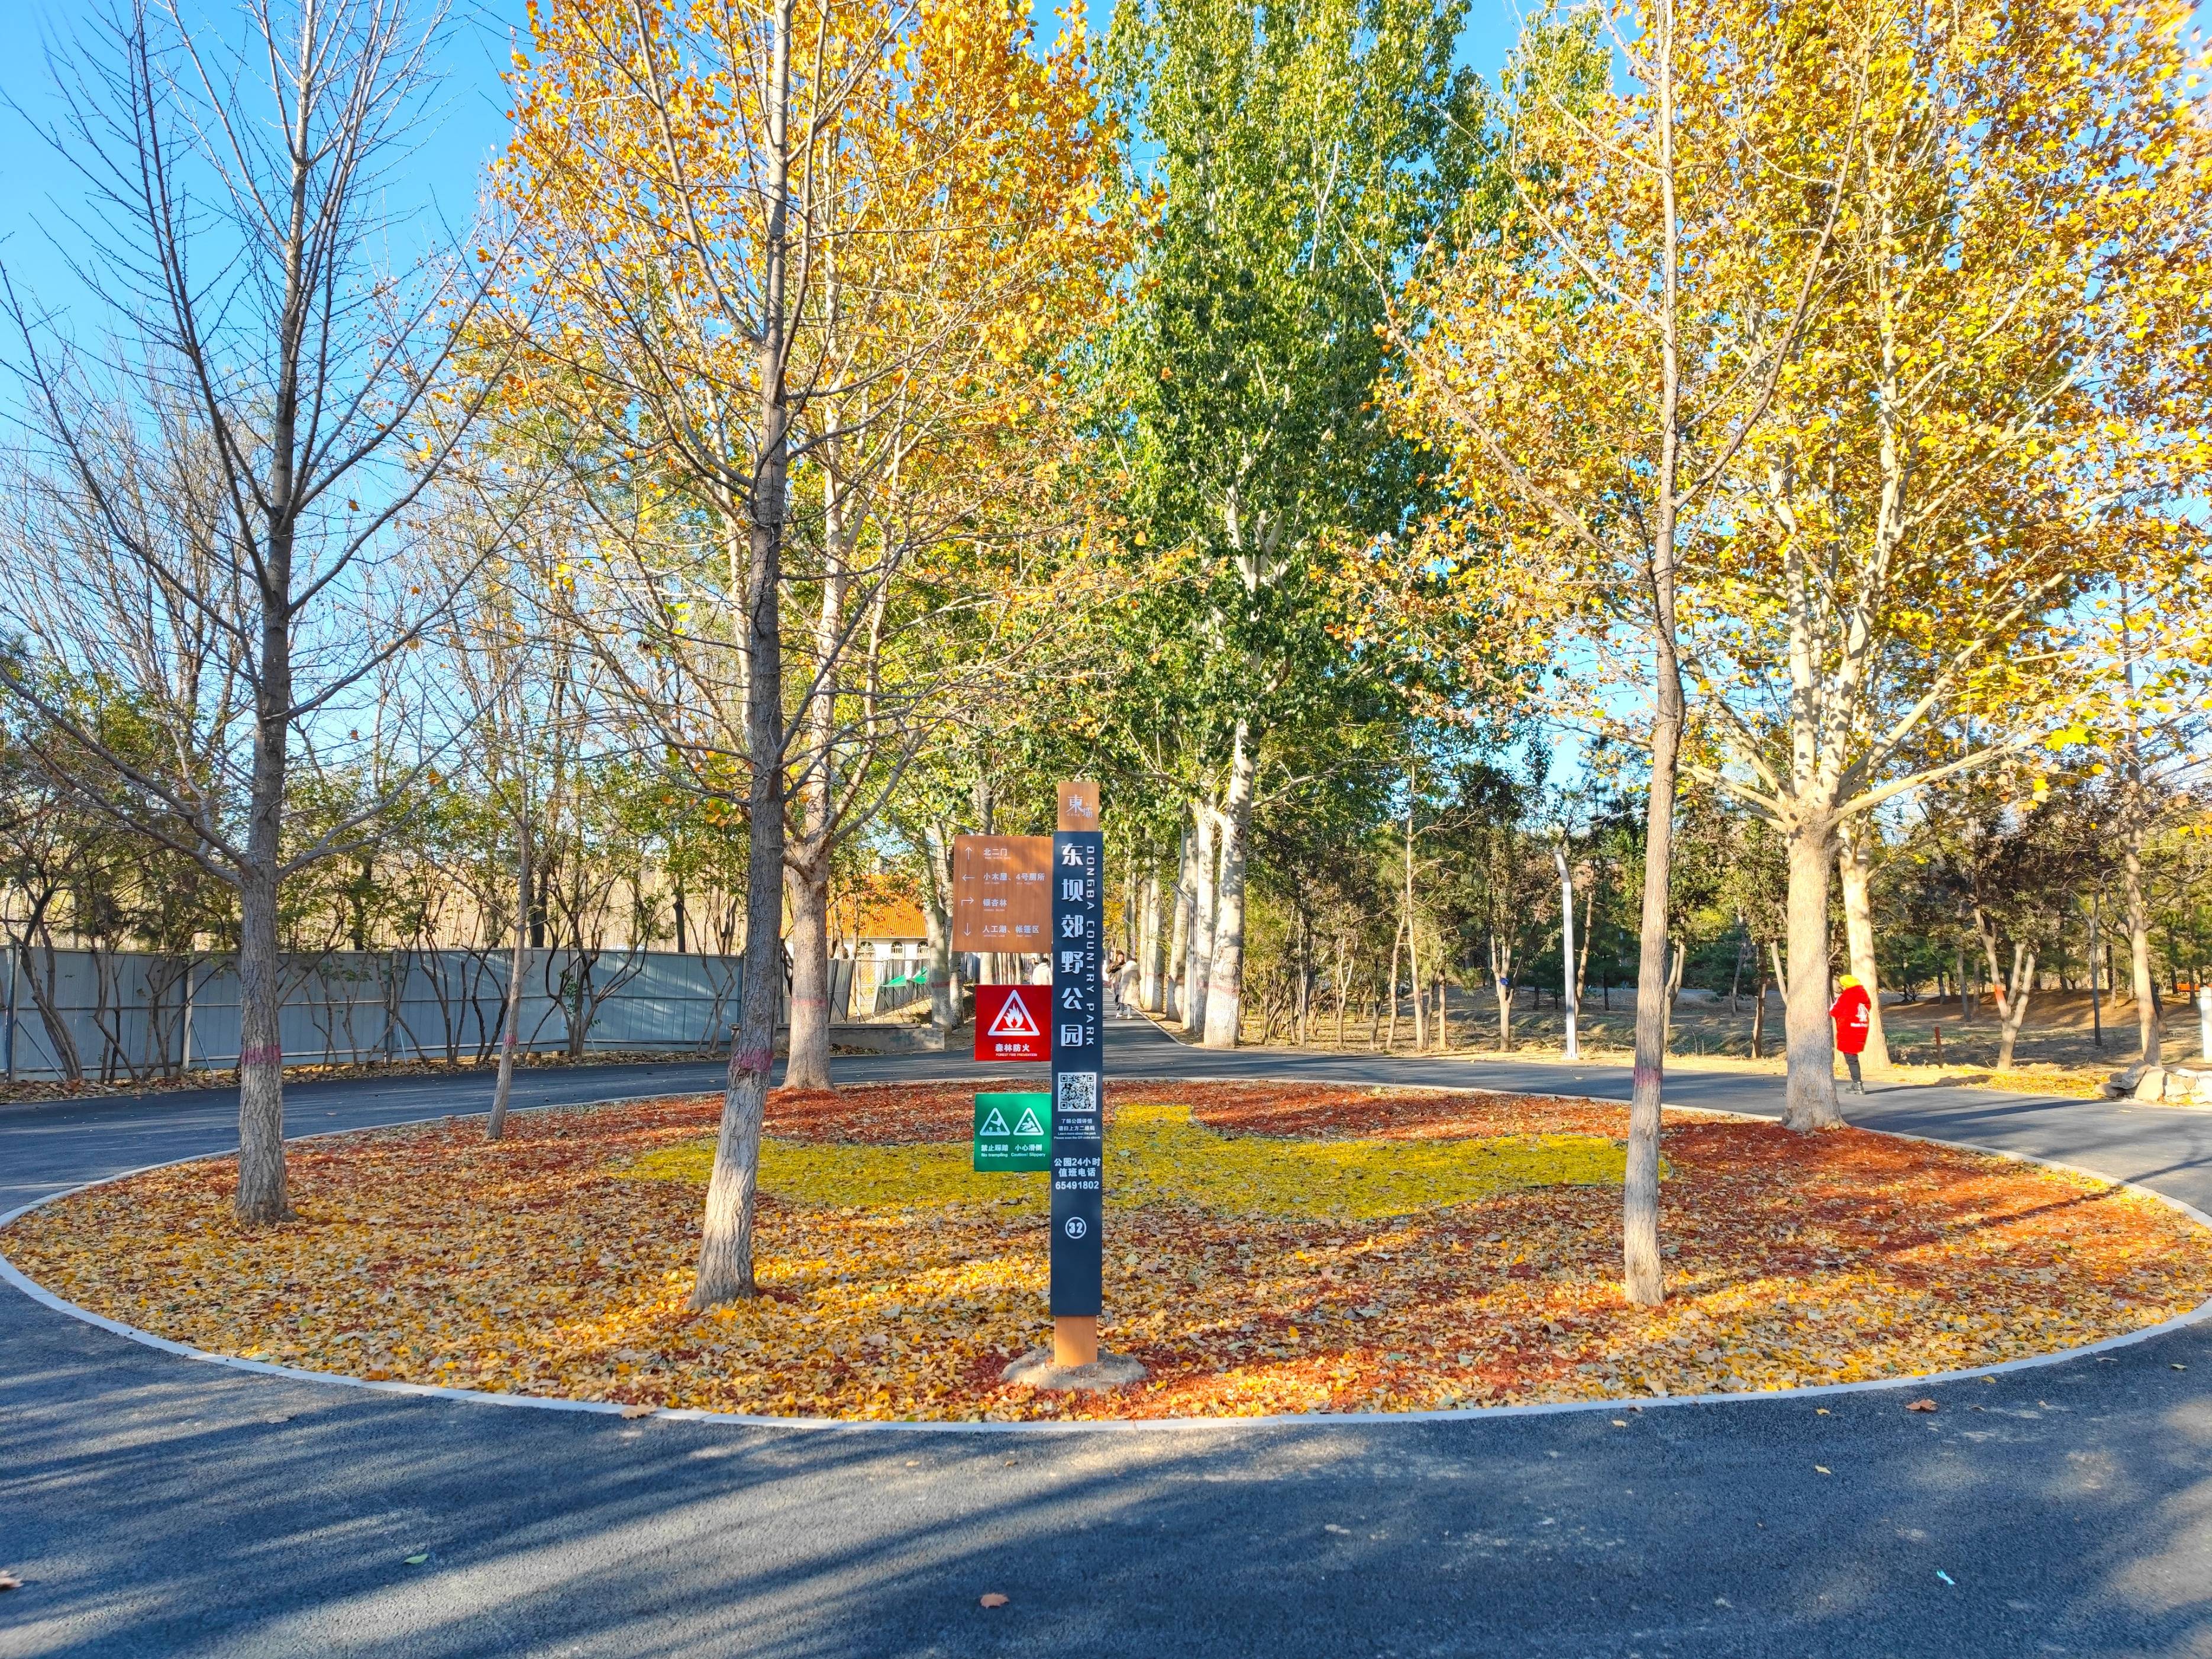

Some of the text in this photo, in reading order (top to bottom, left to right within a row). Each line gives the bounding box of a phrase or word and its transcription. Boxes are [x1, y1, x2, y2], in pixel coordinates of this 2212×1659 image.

[984, 848, 1007, 856] 北二门
[983, 899, 1007, 907] 银杏林
[1061, 843, 1084, 1047] 东坝郊野公园
[1086, 845, 1094, 1045] DONGBA COUNTRY PARK
[995, 1044, 1030, 1052] 森林防火
[1054, 1157, 1101, 1167] 公园24小时
[1058, 1167, 1096, 1177] 值班电话
[1055, 1180, 1099, 1190] 65491802
[1068, 1222, 1083, 1234] 32
